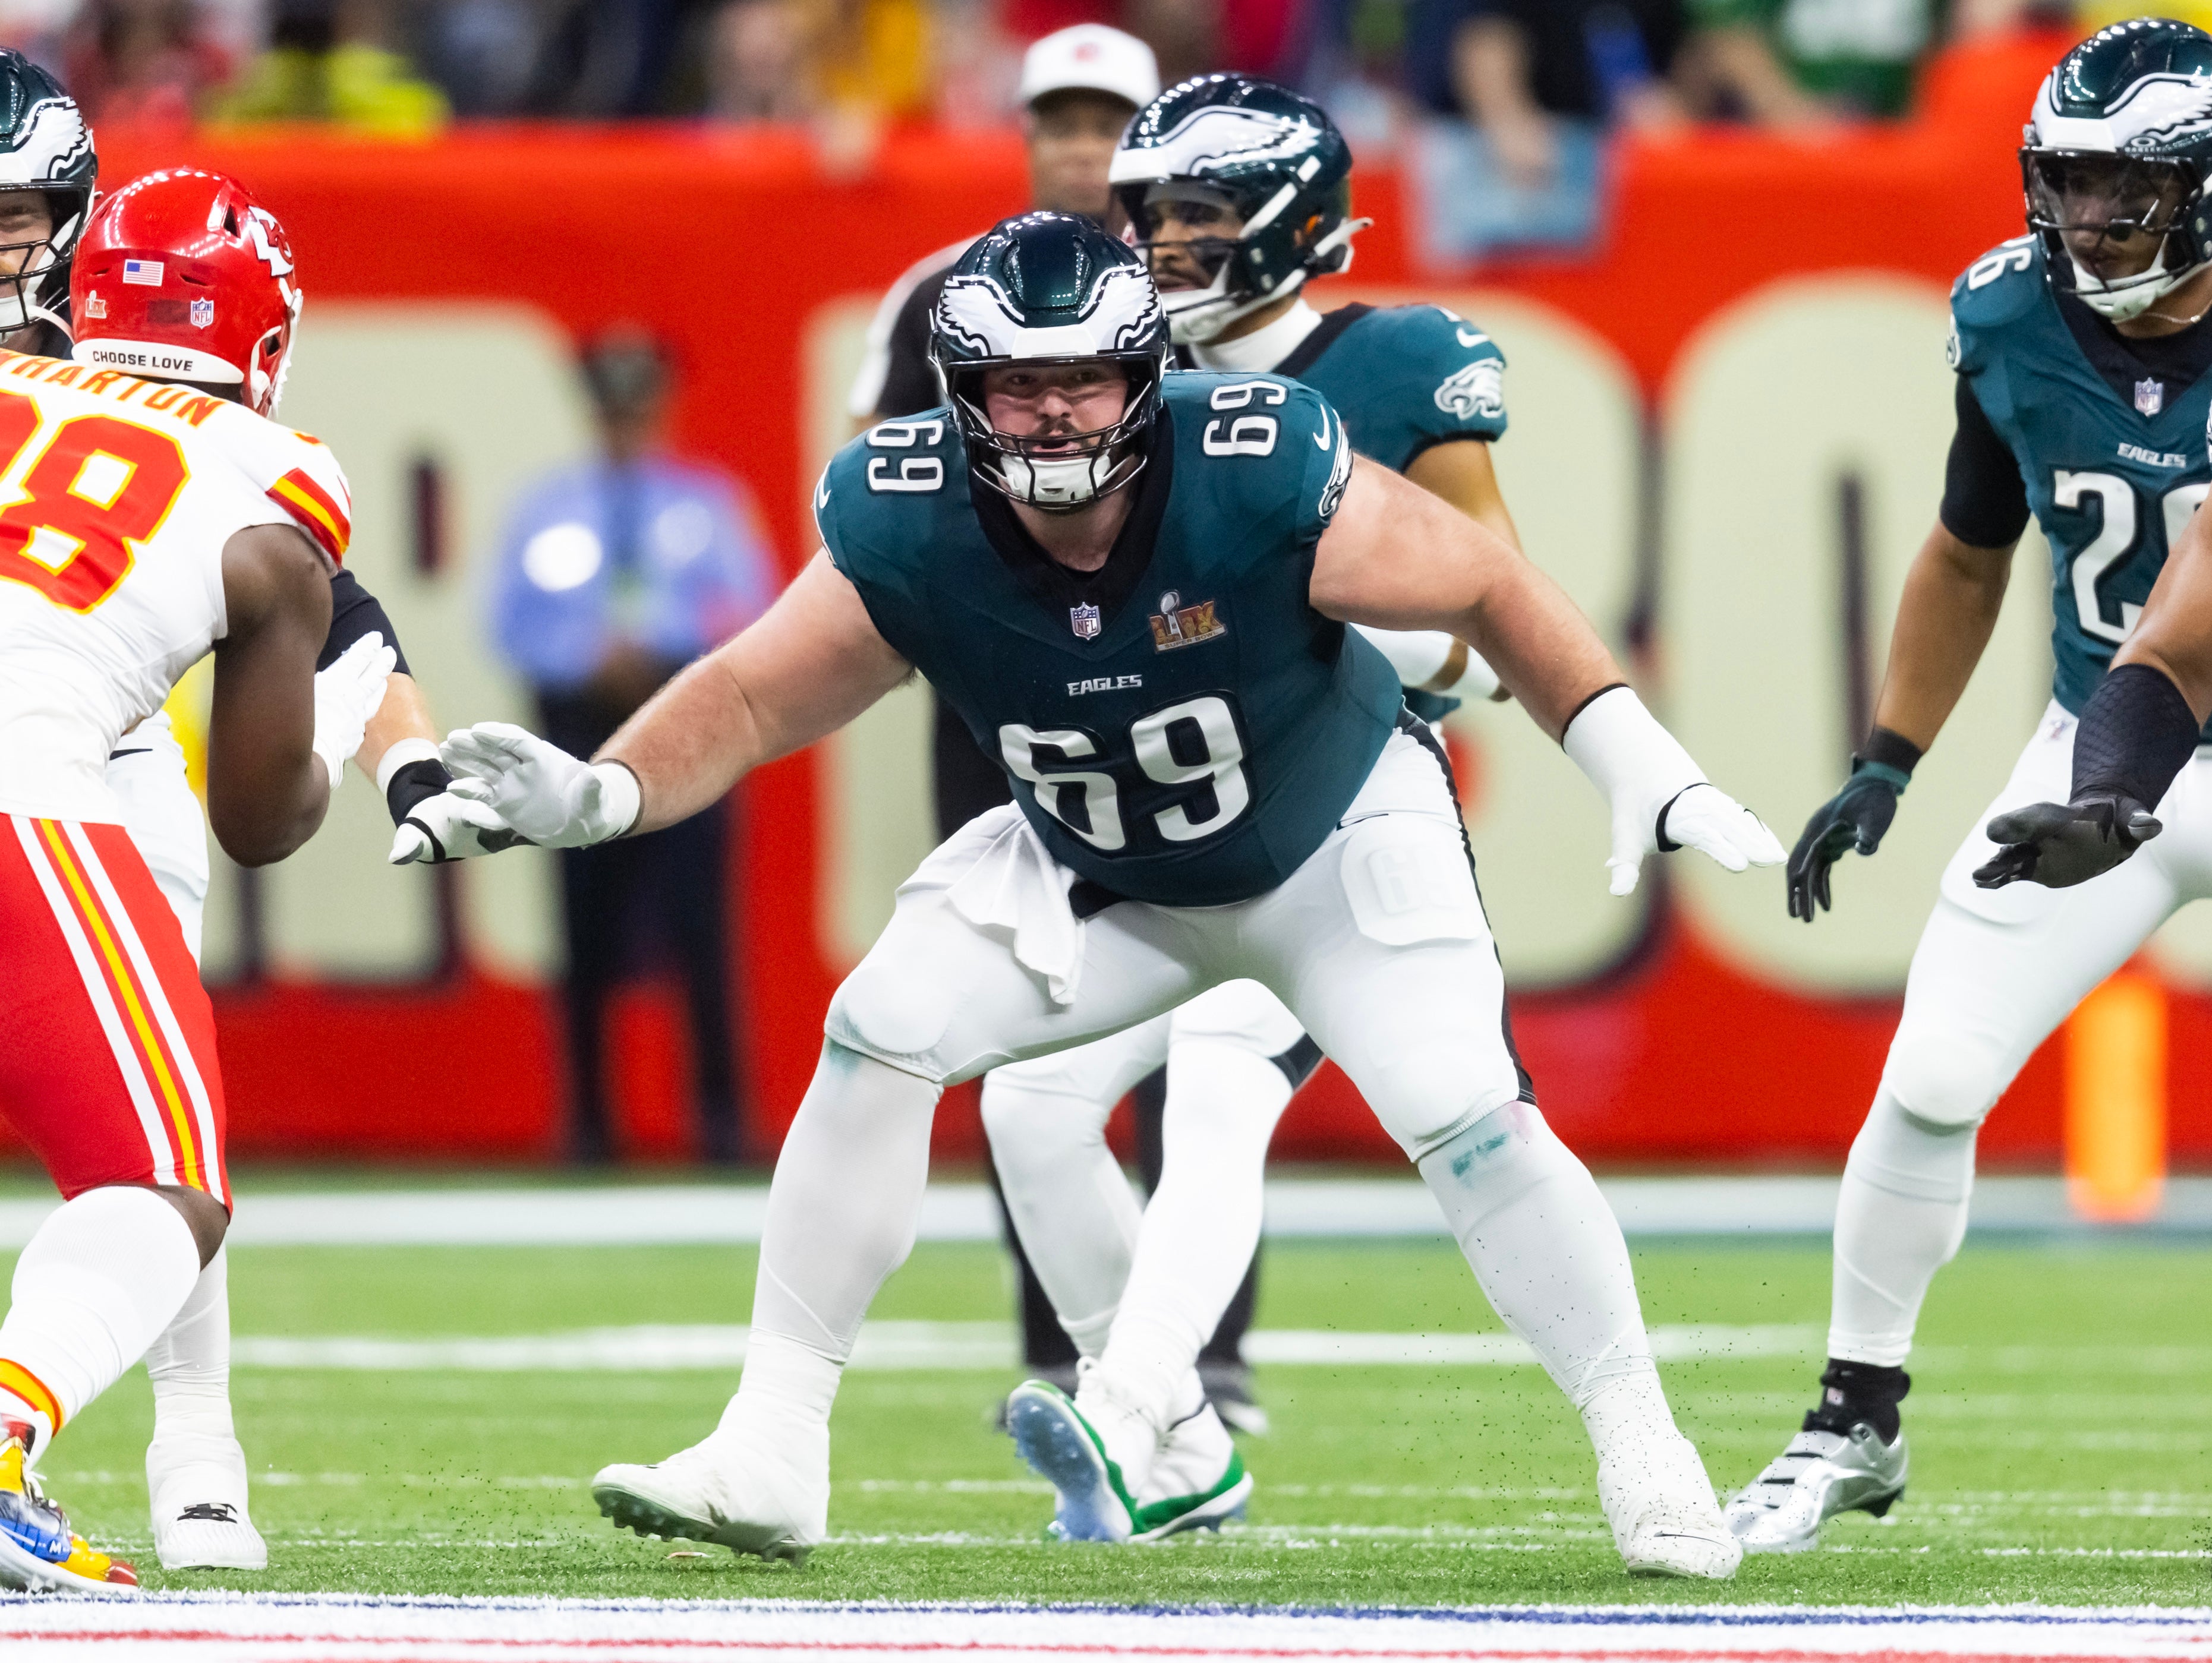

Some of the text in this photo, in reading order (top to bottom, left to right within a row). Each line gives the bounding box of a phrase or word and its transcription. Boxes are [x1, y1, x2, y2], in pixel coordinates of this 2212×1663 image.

[1968, 233, 2037, 291] 6
[194, 311, 210, 323] NFL
[93, 351, 193, 371] CHOOSE LOVE
[0, 347, 226, 429] HARTON
[1203, 381, 1287, 456] 69
[868, 420, 943, 491] 69
[2117, 442, 2187, 469] EAGLES
[1077, 620, 1096, 633] NFL
[1067, 674, 1142, 696] EAGLES
[998, 696, 1249, 851] 69
